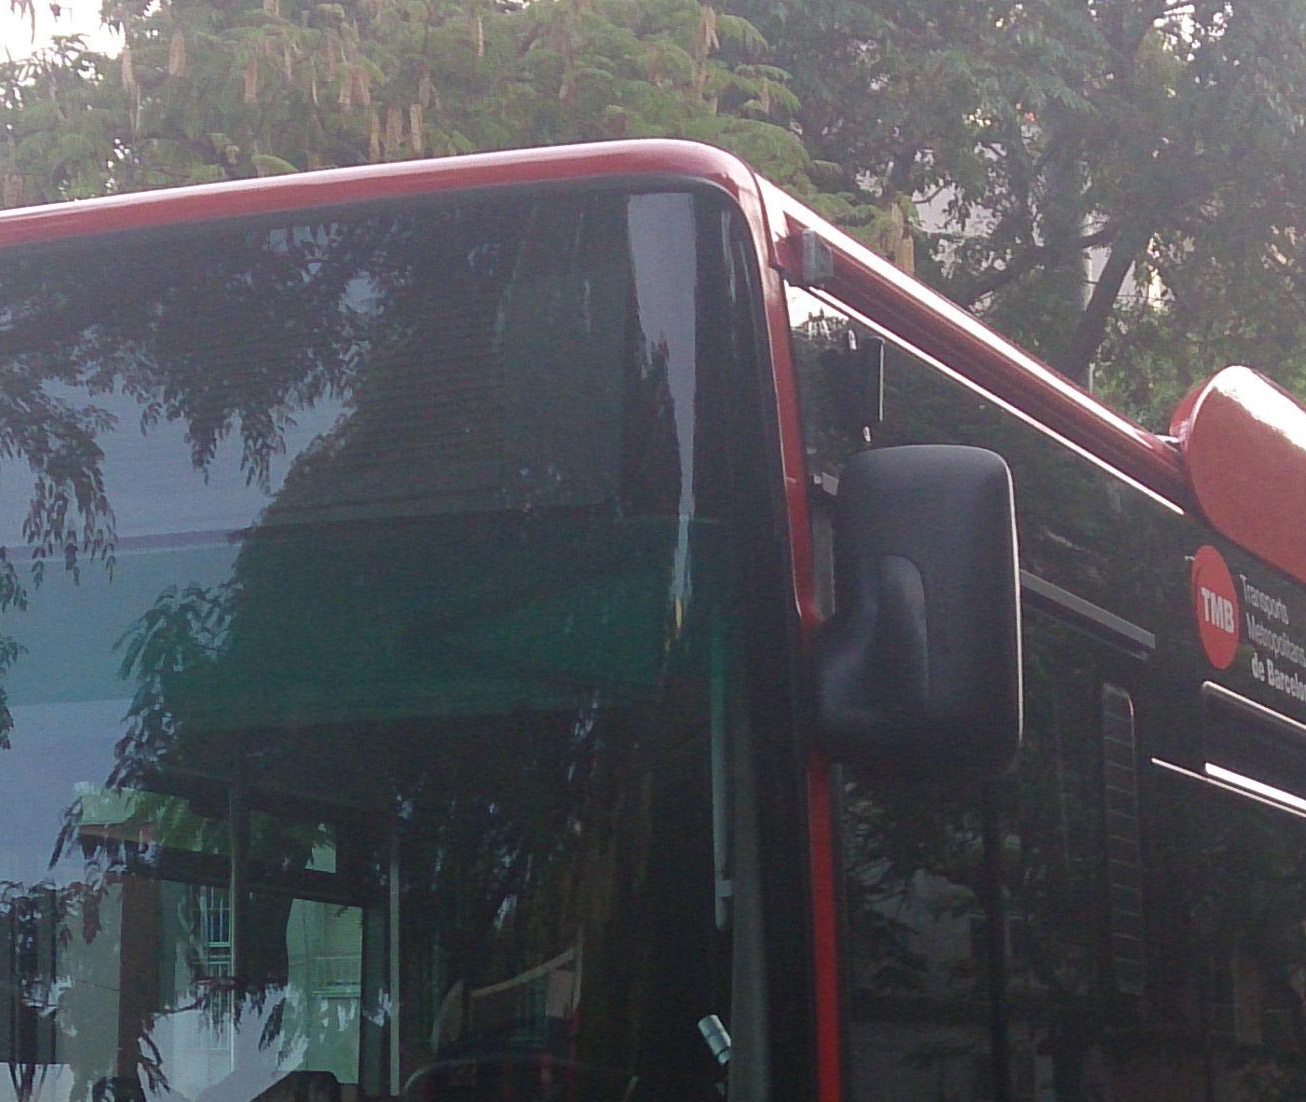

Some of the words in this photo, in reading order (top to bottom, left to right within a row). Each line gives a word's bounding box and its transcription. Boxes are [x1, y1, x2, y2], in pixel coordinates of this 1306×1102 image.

[1201, 587, 1234, 634] TMB
[1240, 574, 1289, 625] Transports
[1246, 612, 1306, 668] Metropolitans
[1252, 652, 1265, 682] de
